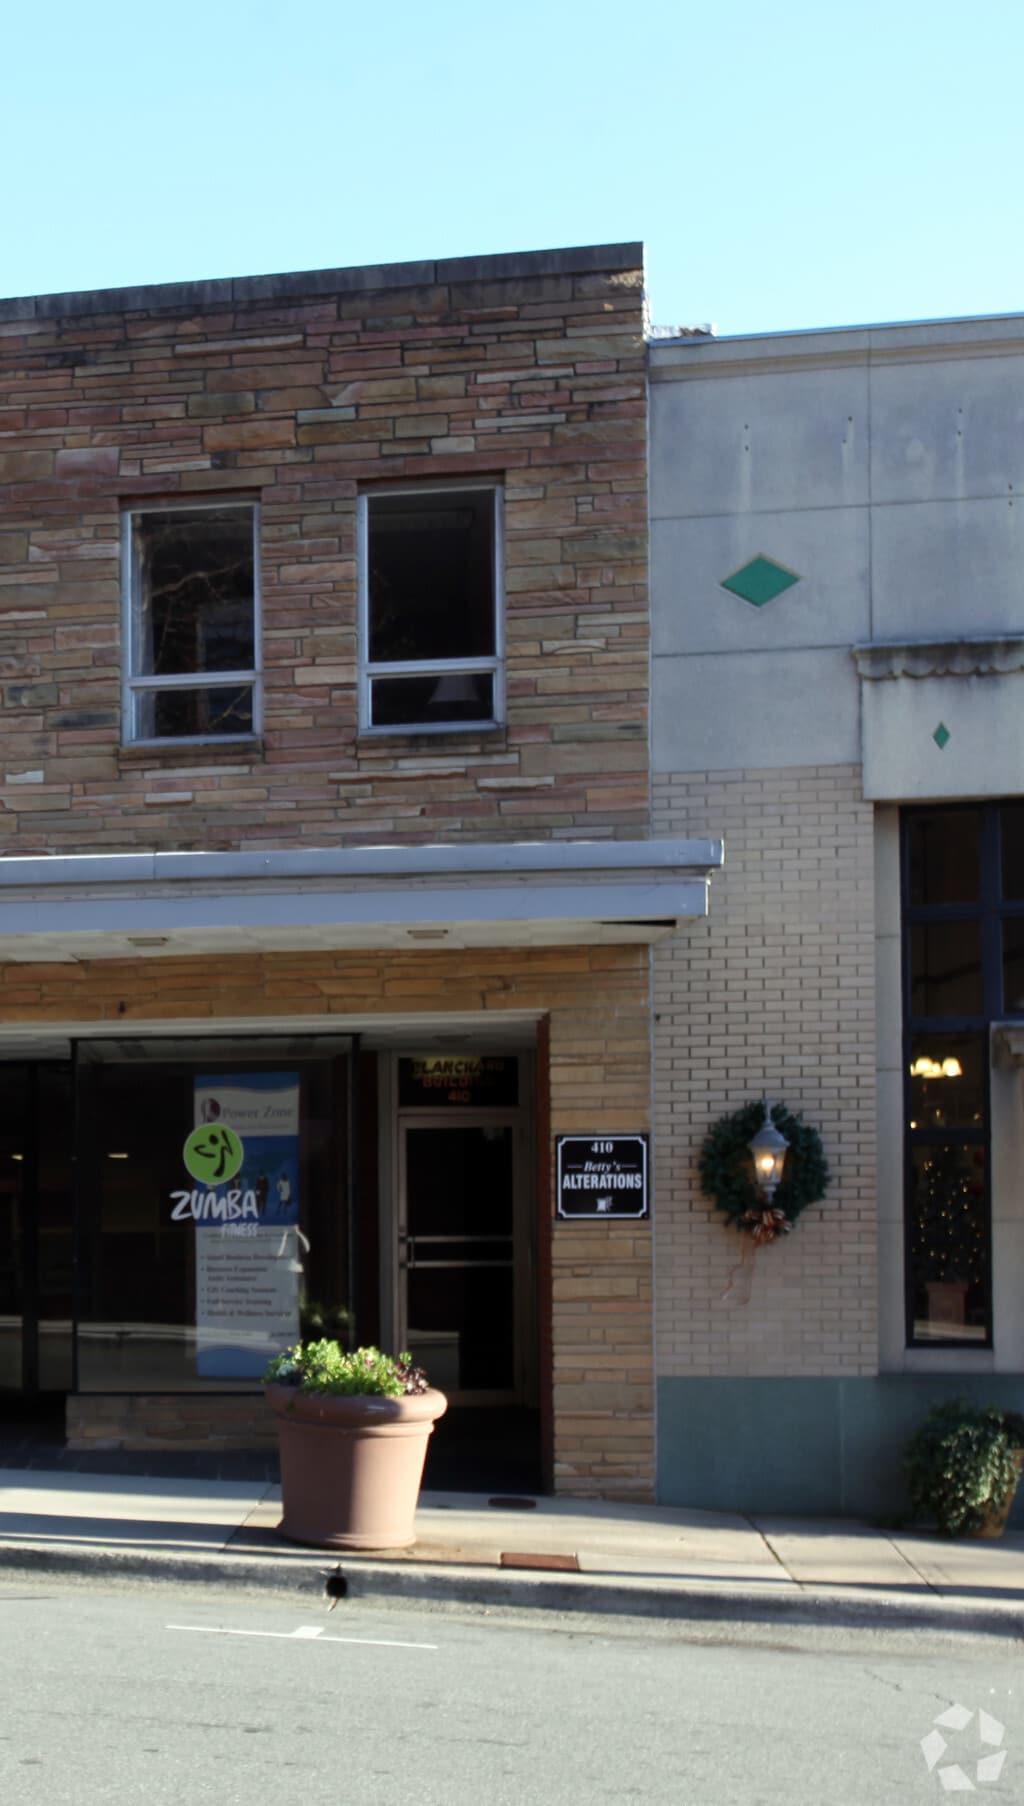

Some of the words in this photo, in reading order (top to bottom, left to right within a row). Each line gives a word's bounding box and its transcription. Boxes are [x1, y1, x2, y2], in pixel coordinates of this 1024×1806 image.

[590, 1141, 614, 1154] 410
[584, 1160, 622, 1174] Betty's
[562, 1174, 643, 1190] ALTERATIONS
[168, 1189, 259, 1221] ZUMBA
[222, 1222, 260, 1238] FITNESS
